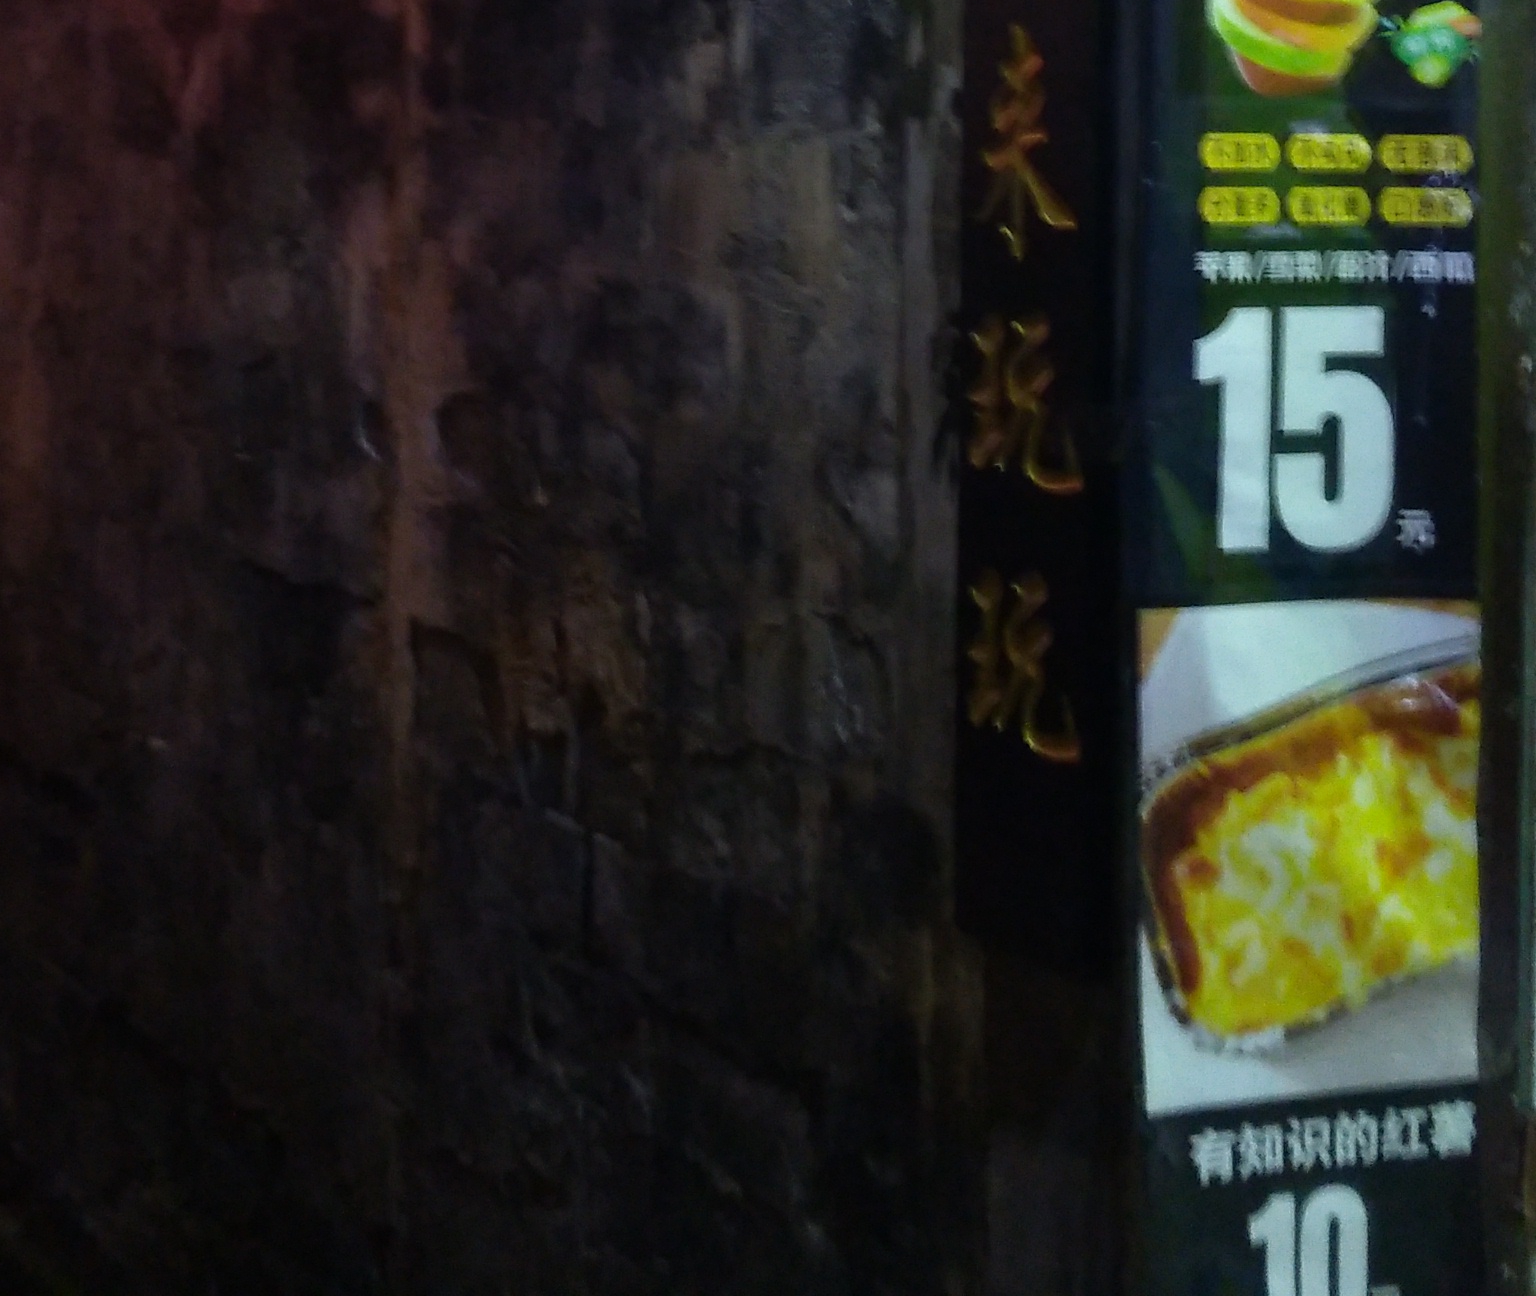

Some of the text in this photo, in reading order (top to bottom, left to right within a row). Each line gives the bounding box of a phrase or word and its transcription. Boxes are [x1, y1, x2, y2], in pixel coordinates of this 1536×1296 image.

[1192, 305, 1396, 554] 15
[1189, 1099, 1477, 1188] 有知识的红薯
[1247, 1181, 1370, 1296] 10
